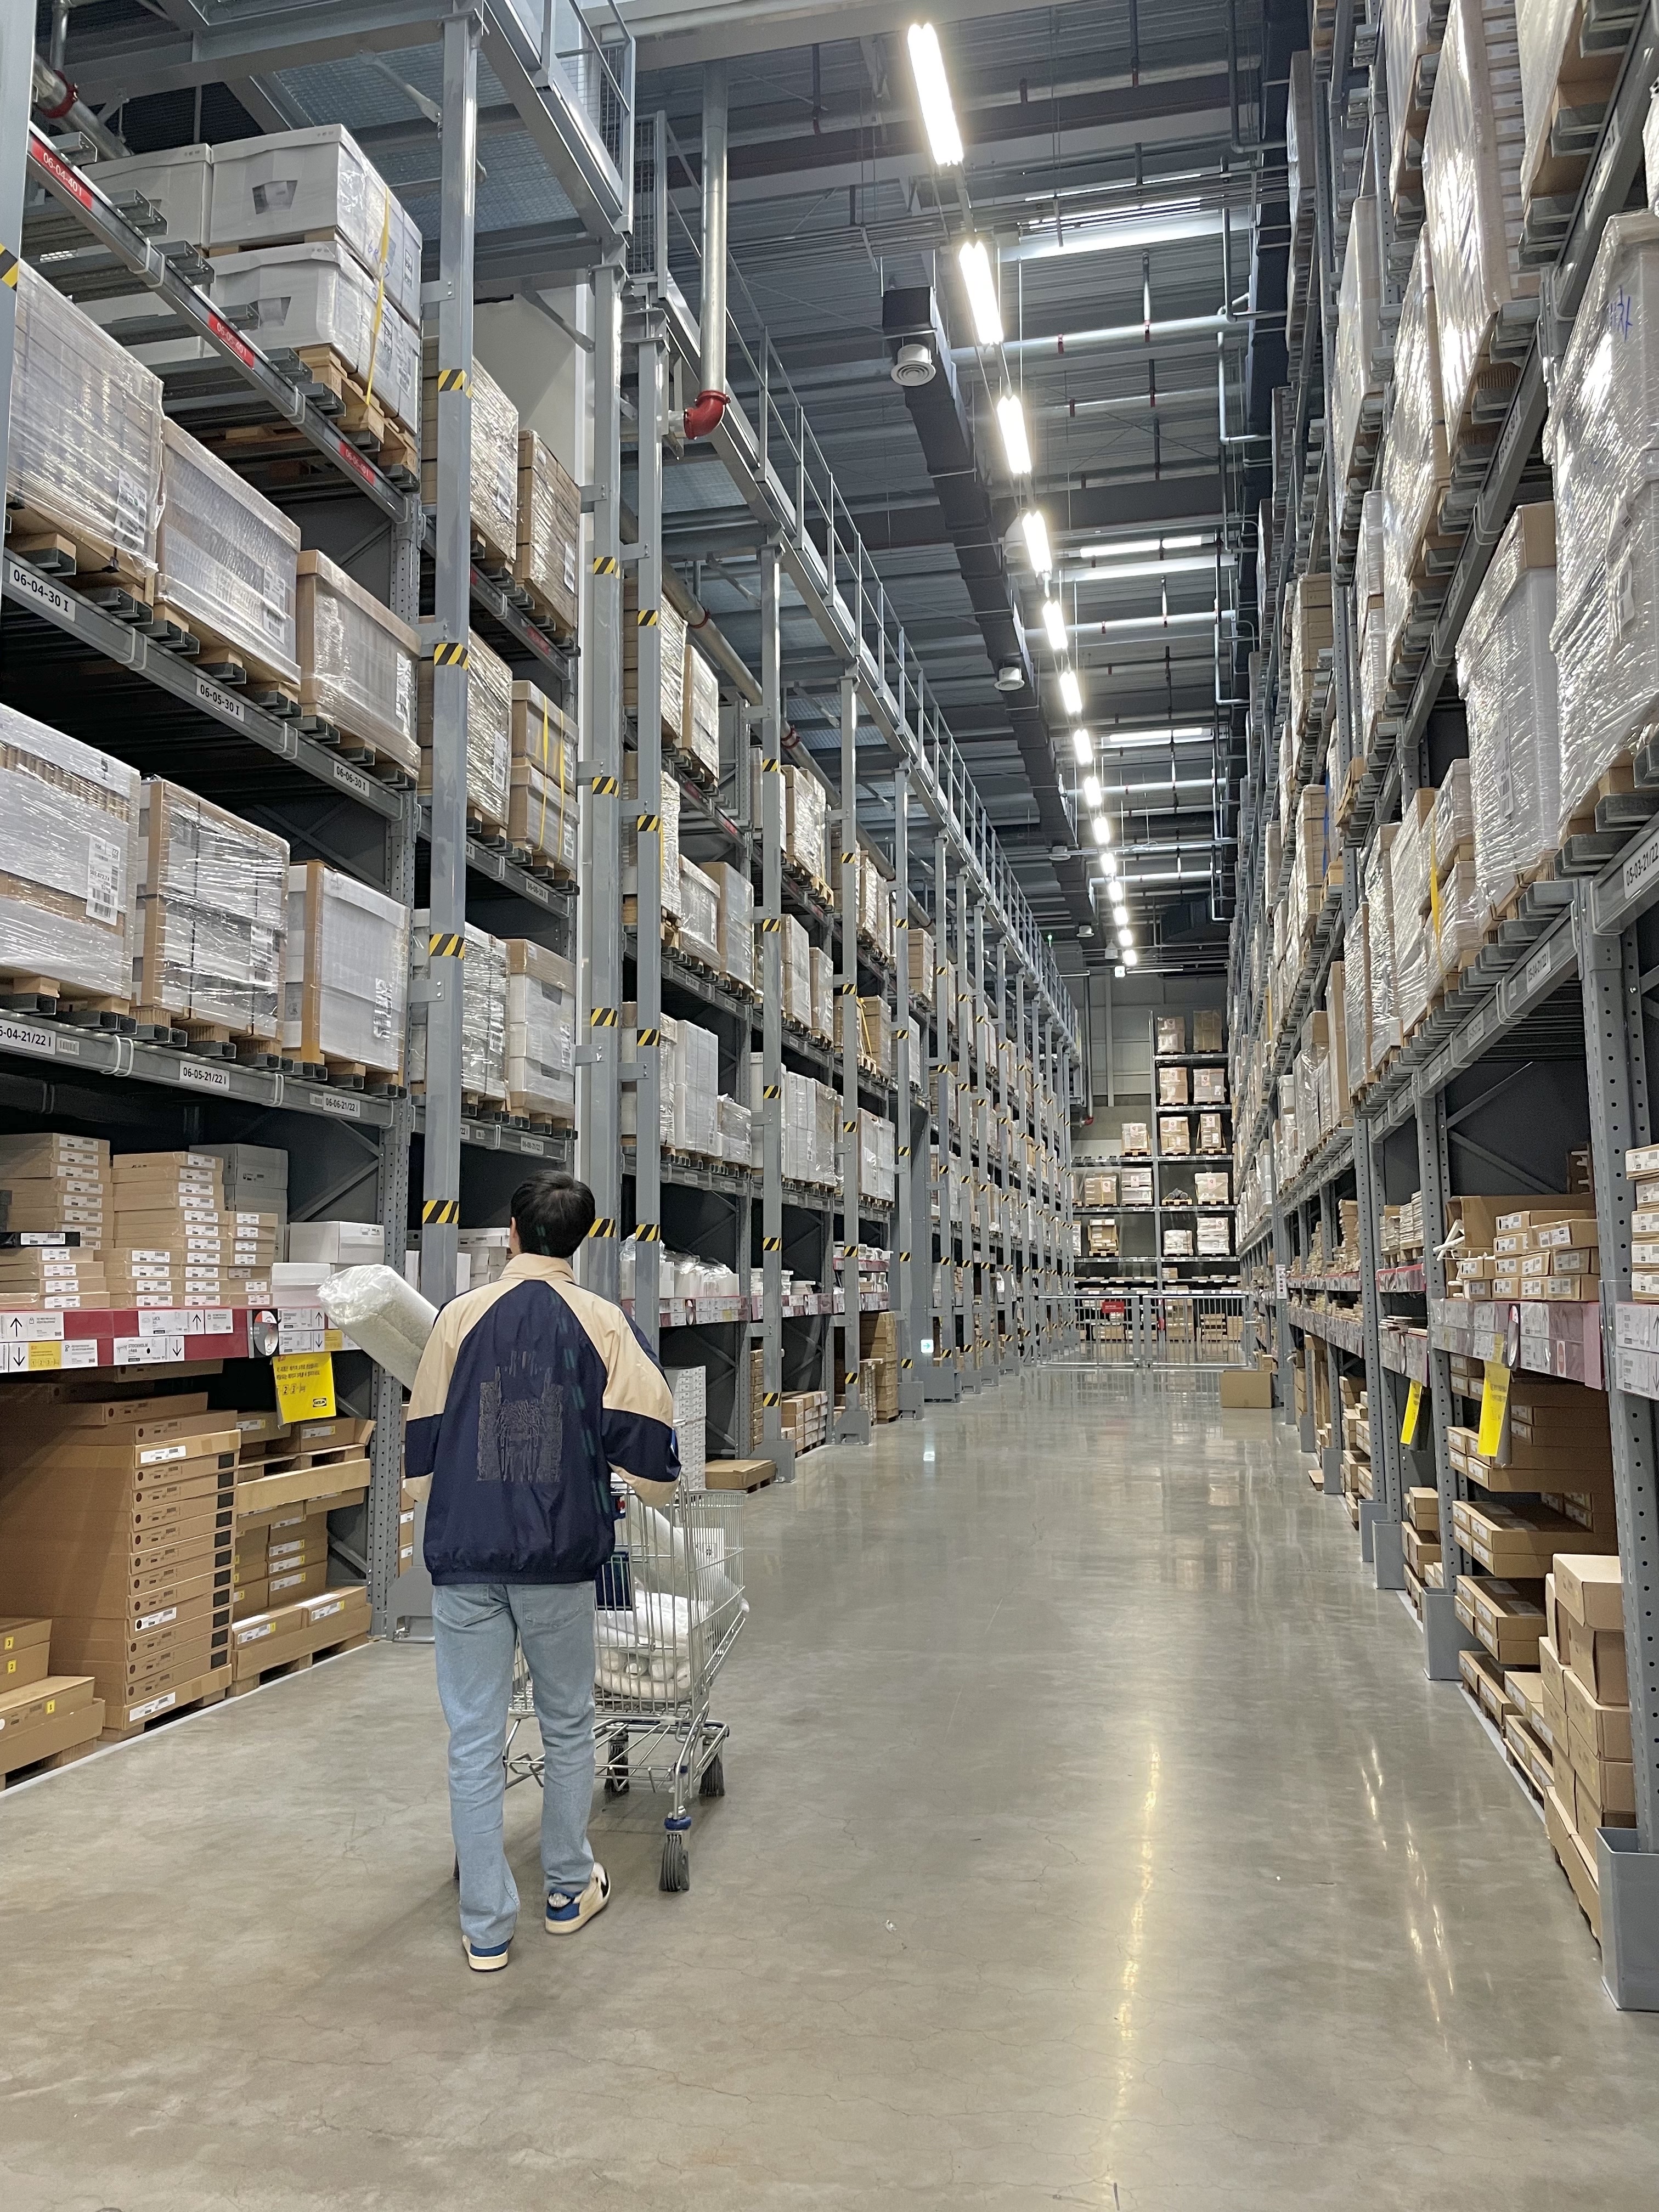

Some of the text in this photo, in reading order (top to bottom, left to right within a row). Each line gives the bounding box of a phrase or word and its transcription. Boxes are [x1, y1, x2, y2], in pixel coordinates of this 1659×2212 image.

[43, 152, 78, 192] 06-04-40
[217, 322, 244, 354] 06-05-40
[14, 569, 69, 612] 06-04-30 I
[200, 684, 239, 716] 06-05-30 I
[336, 766, 362, 788] 06-06-30
[0, 1025, 46, 1046] 6-04-21/22
[183, 1067, 222, 1084] 06-05-21/22
[325, 1098, 355, 1111] 06-06-21/22
